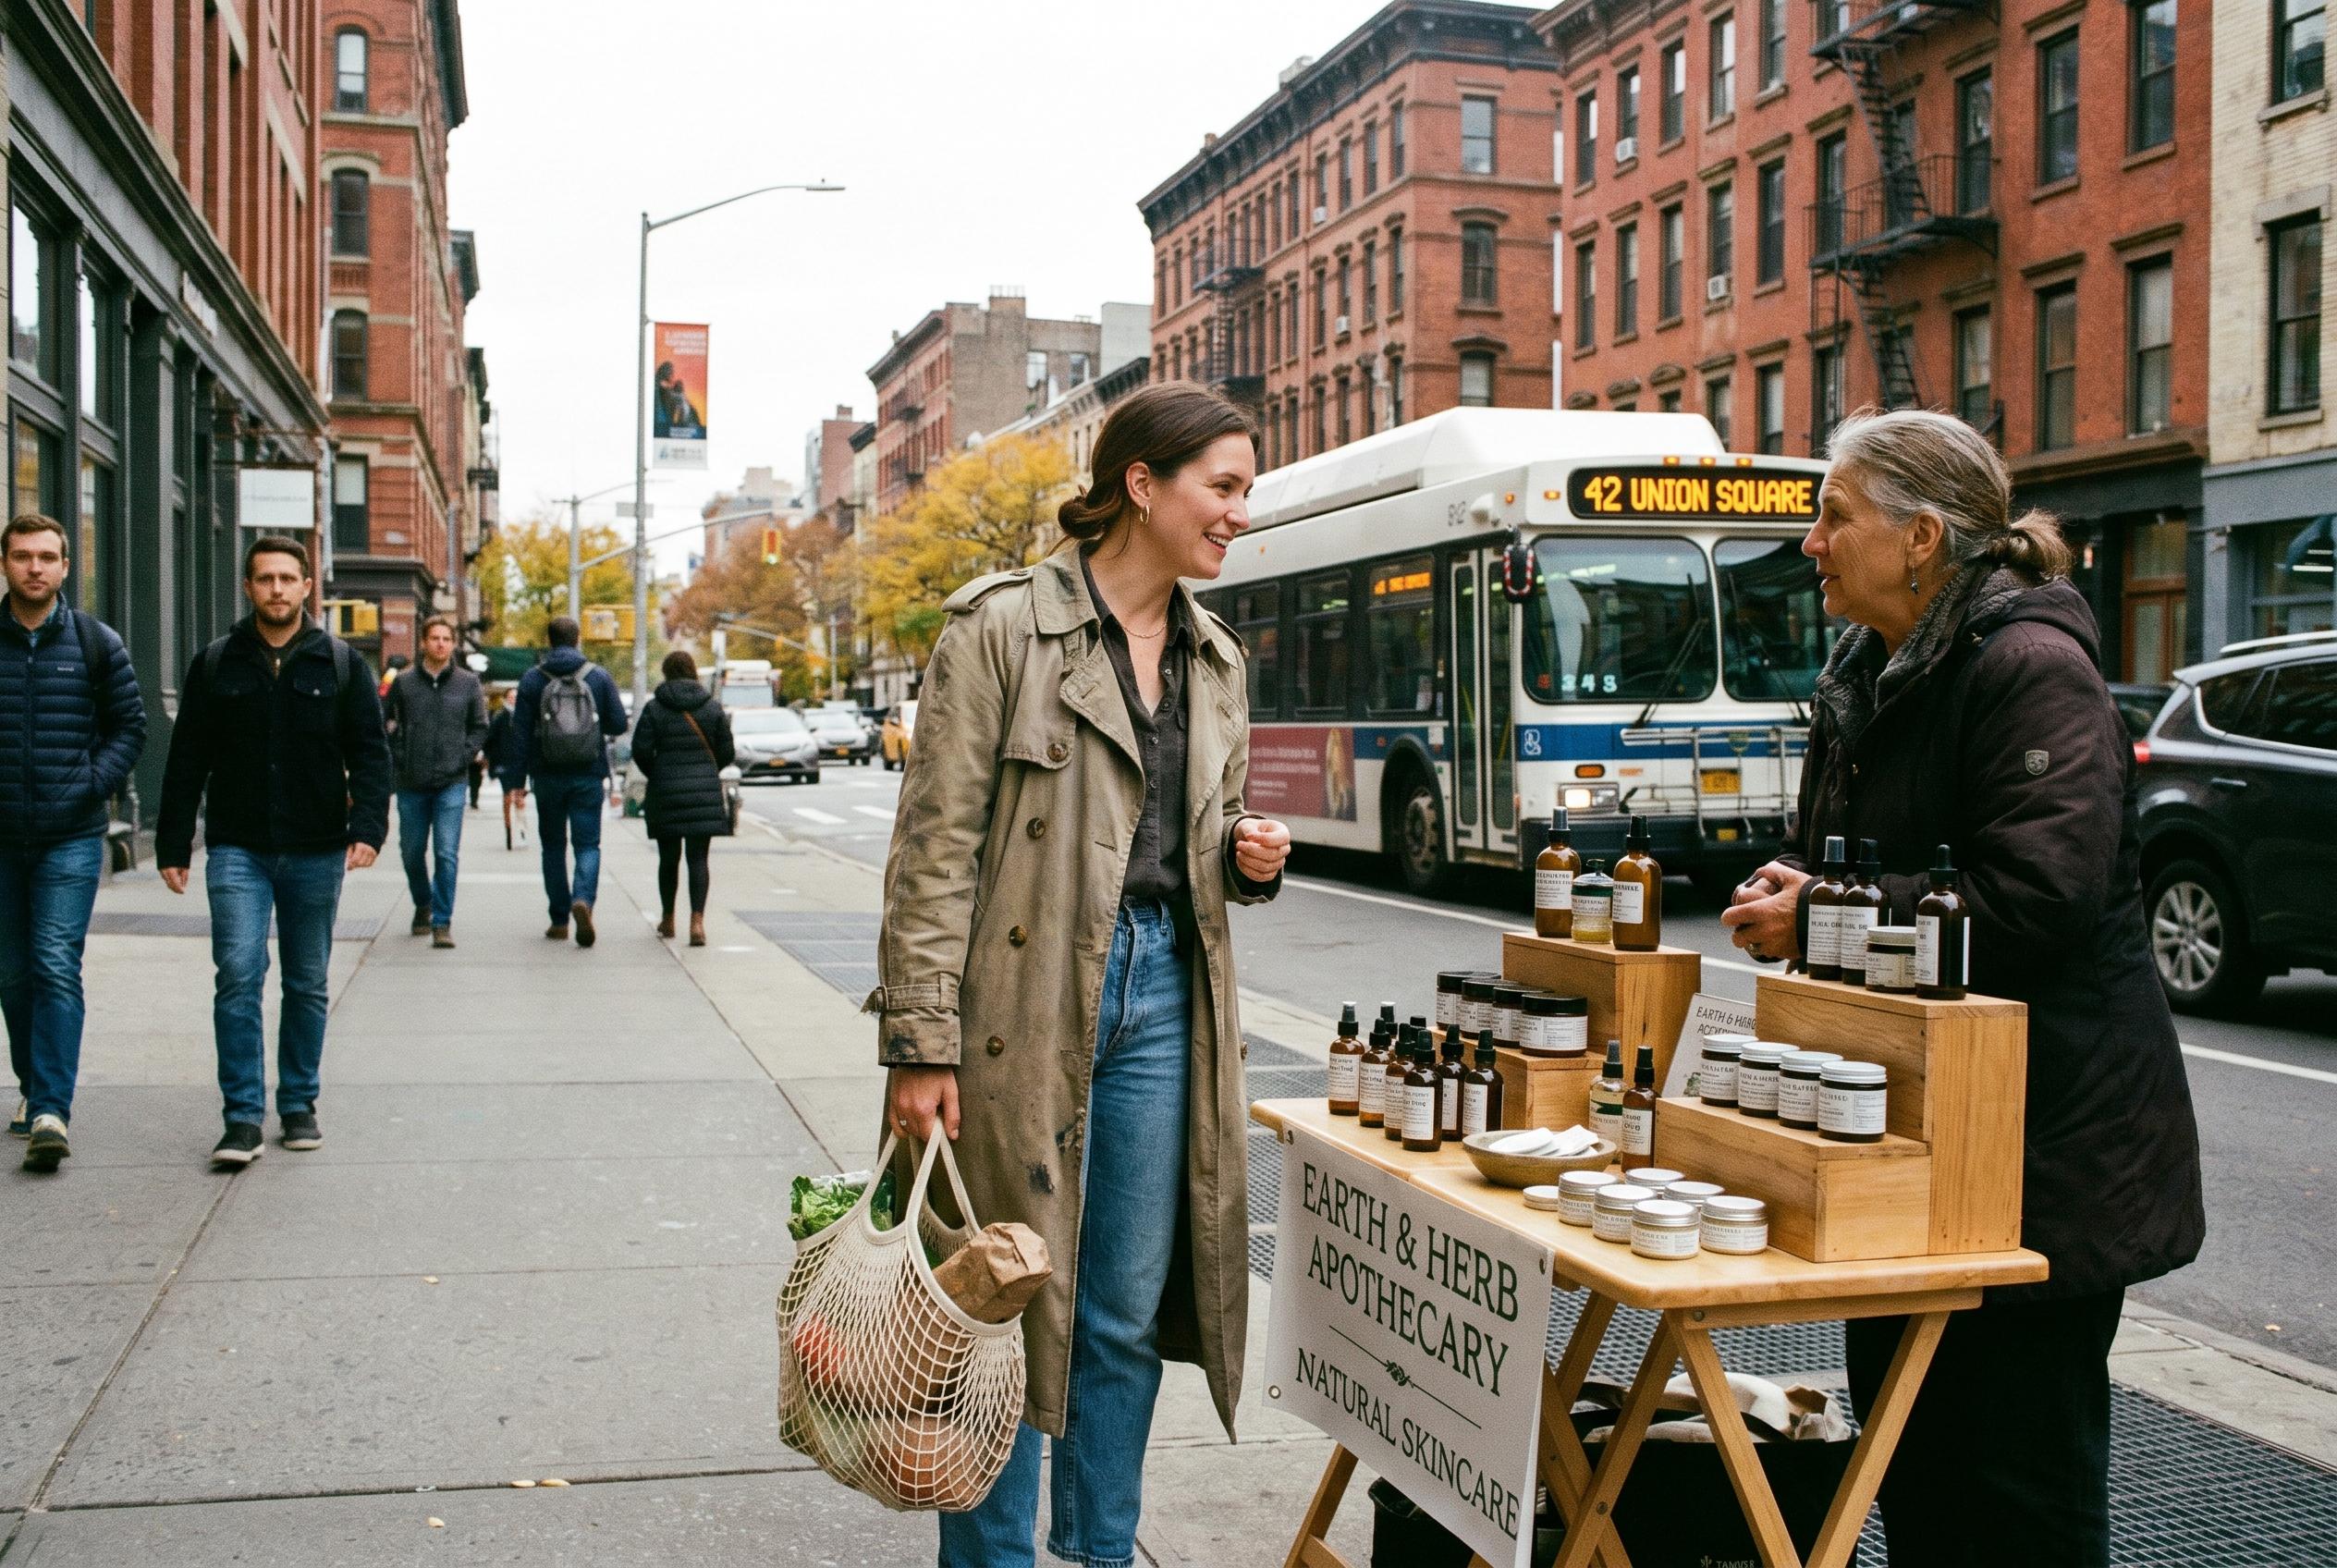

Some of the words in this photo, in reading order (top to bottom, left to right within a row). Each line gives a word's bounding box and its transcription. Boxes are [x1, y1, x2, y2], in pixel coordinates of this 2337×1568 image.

[1584, 475, 1623, 513] 42
[1630, 477, 1710, 513] UNION
[1715, 478, 1815, 514] SQUARE
[1696, 1006, 1727, 1023] EARTH
[1302, 1160, 1389, 1255] EARTH
[1395, 1212, 1418, 1271] &
[1425, 1224, 1520, 1323] HERB
[1306, 1233, 1510, 1398] APOTHECARY
[1295, 1347, 1397, 1447] NATURAL
[1401, 1416, 1520, 1541] SKINCARE
